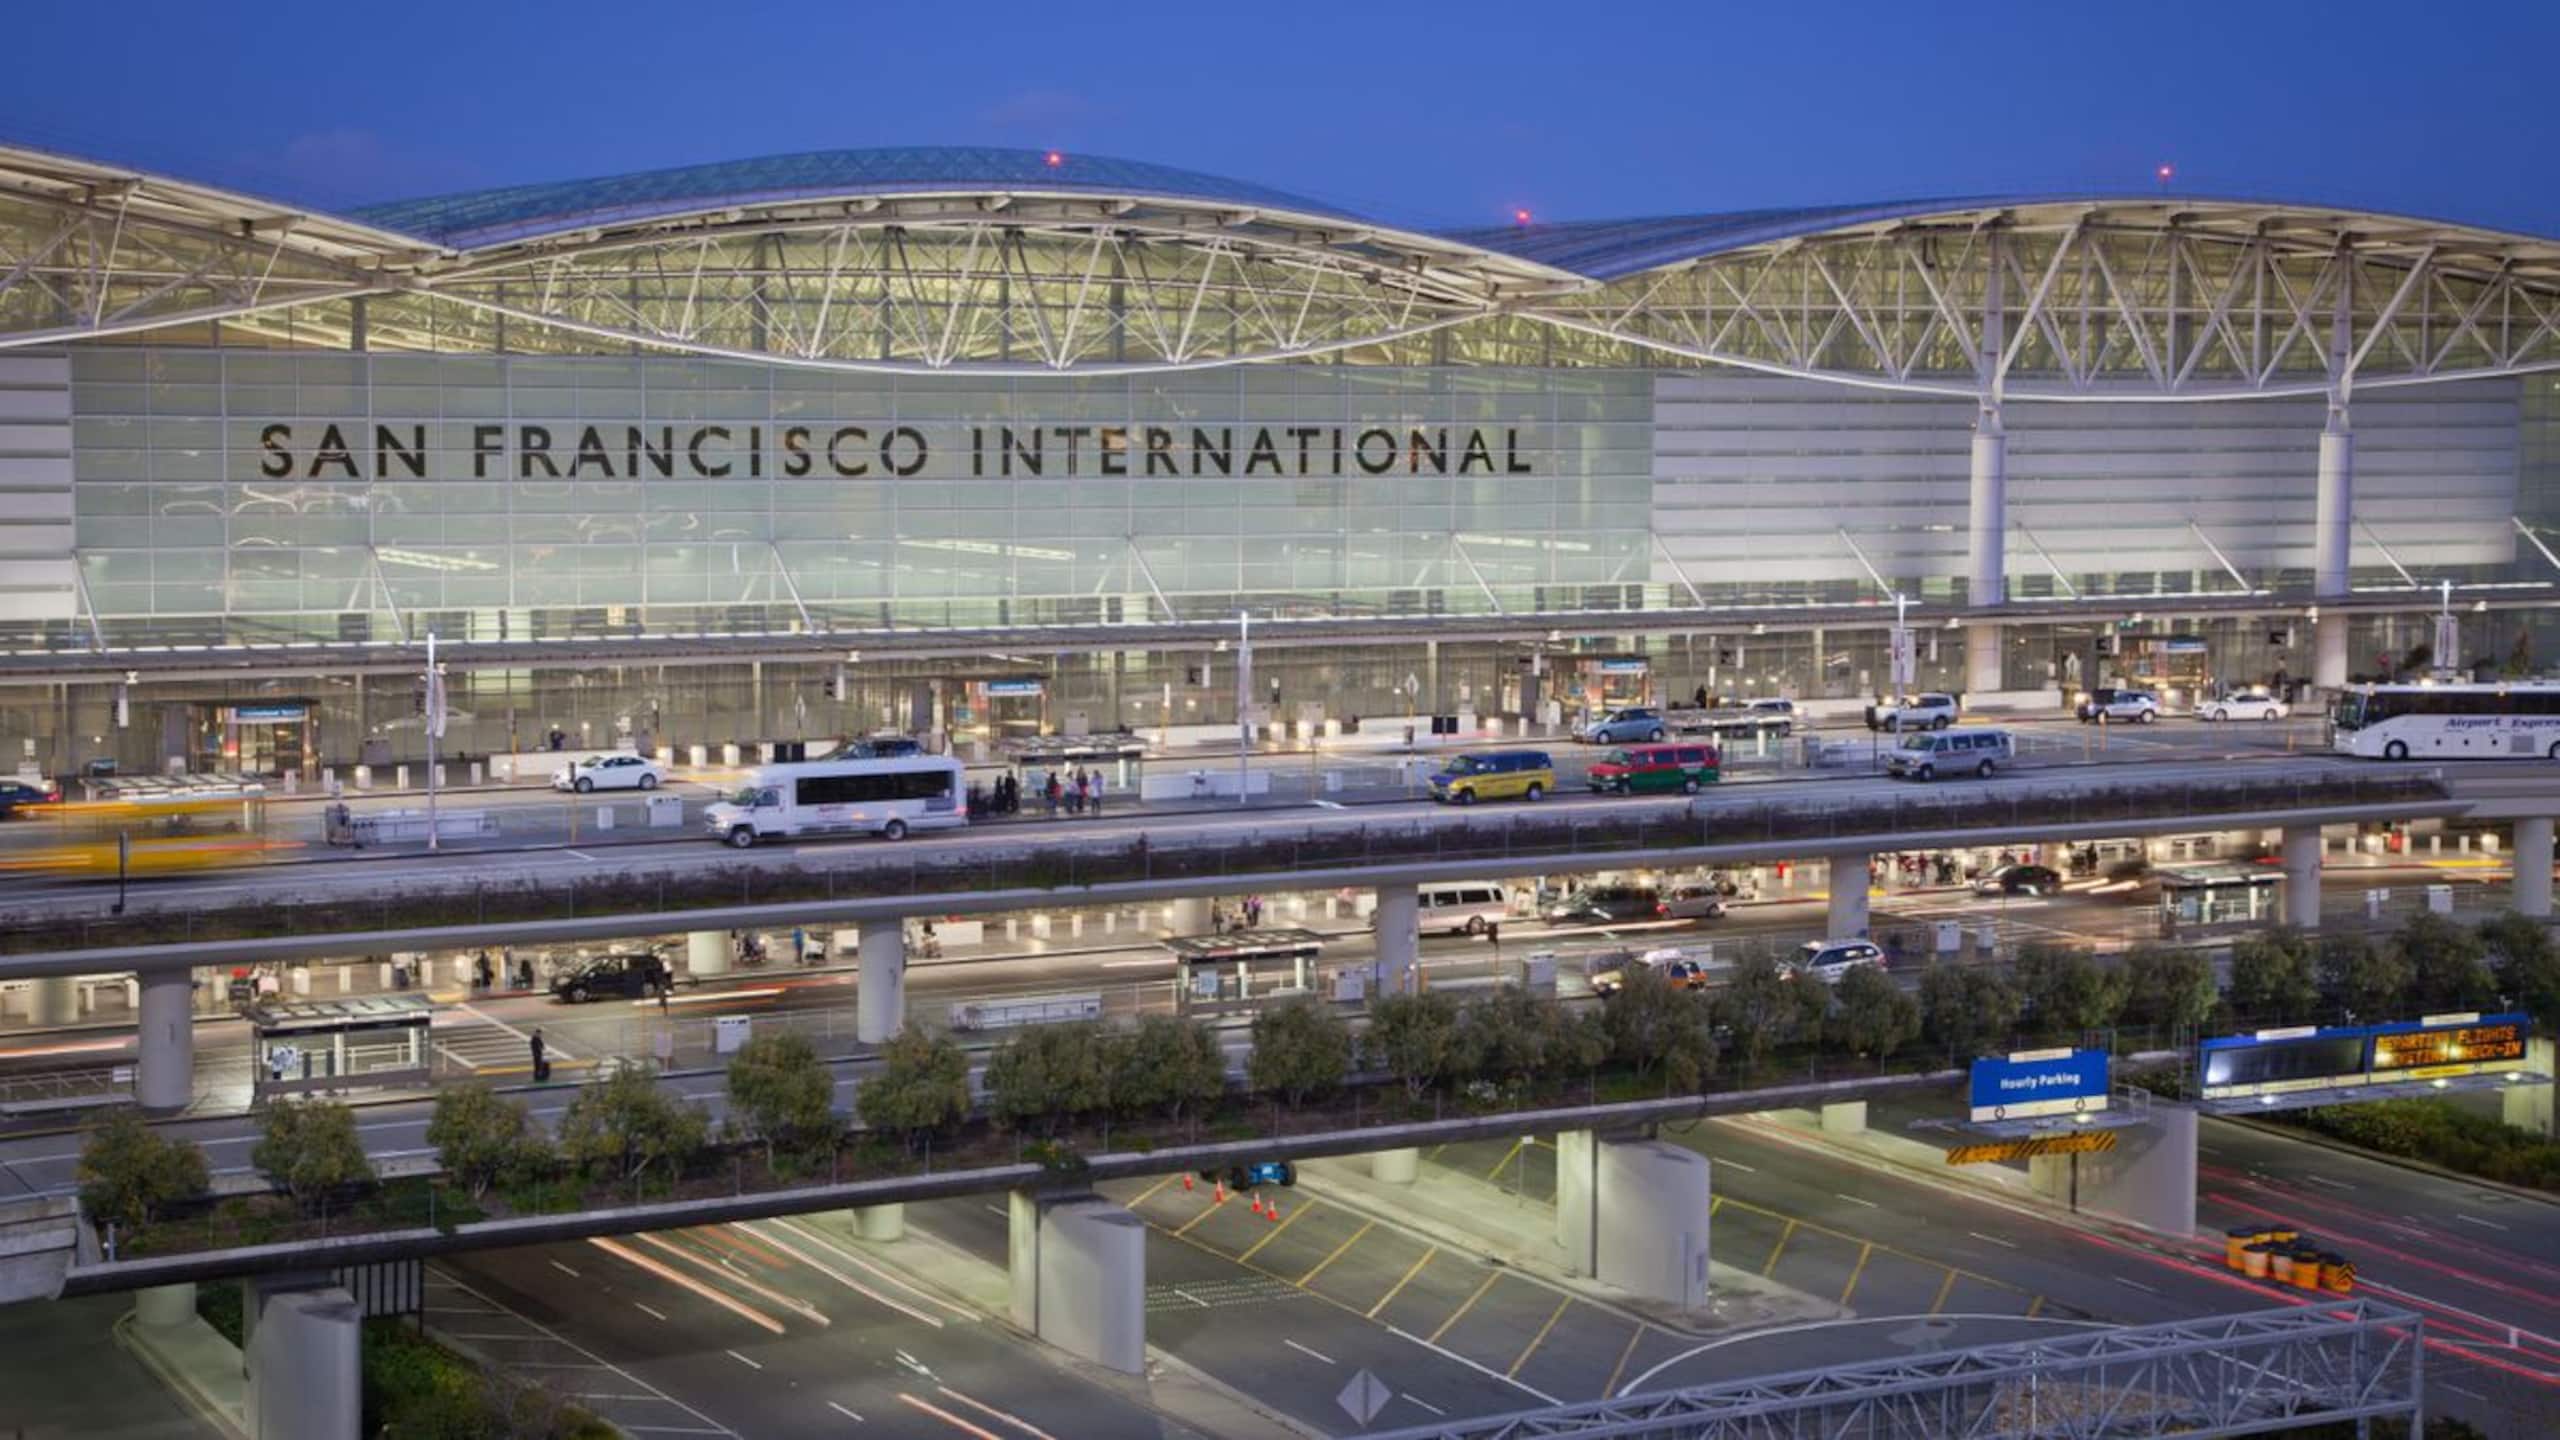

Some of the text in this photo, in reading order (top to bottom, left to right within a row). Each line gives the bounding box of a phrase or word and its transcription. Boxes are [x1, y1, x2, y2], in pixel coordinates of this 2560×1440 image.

[260, 424, 1532, 478] SAN FRANCISCO INTERNATIONAL
[2445, 717, 2500, 728] Airport
[2457, 1026, 2516, 1043] FLIGHTS
[2001, 1072, 2080, 1089] Hourly Parking
